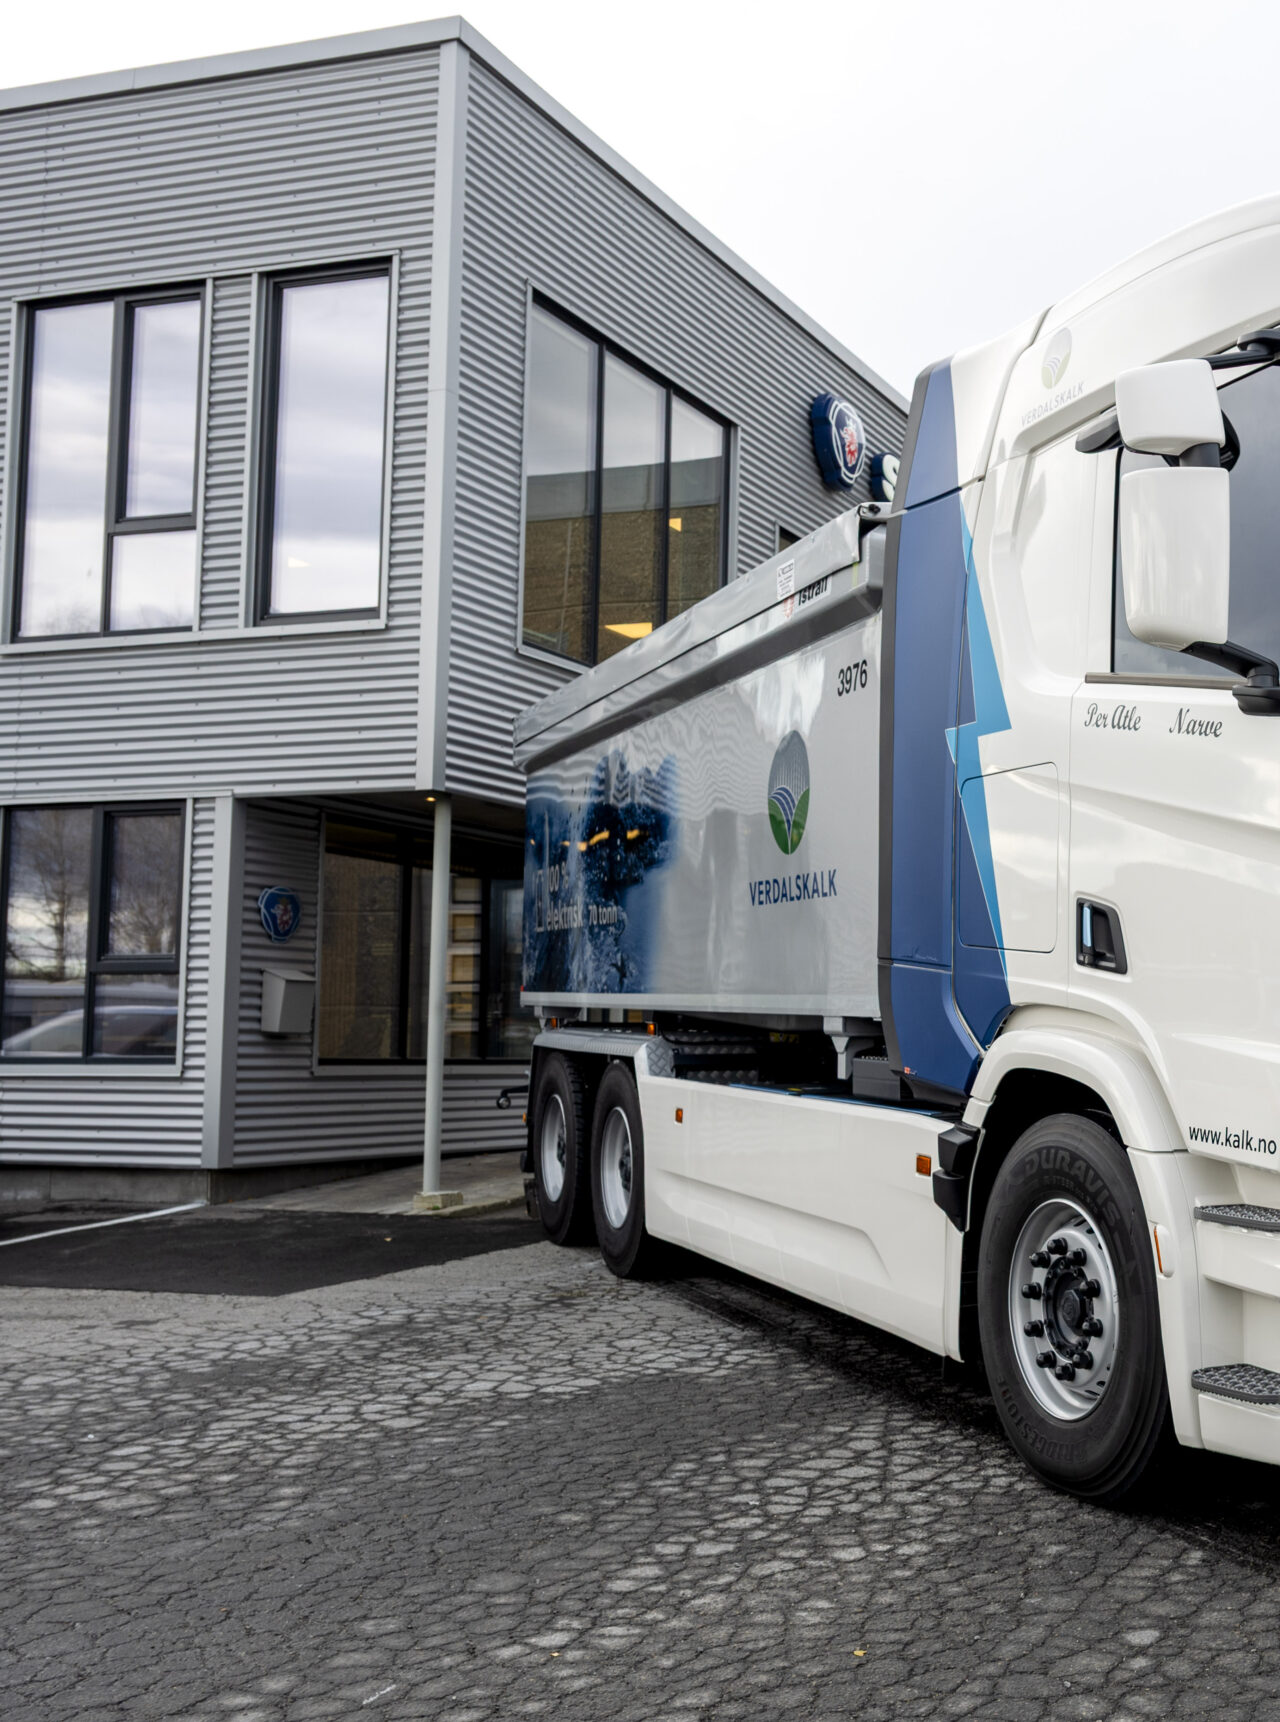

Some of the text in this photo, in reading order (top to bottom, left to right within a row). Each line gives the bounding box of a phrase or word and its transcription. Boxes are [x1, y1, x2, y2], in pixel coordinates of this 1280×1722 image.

[1020, 381, 1085, 427] VERDALSKALK
[837, 659, 868, 697] 3976
[1084, 702, 1142, 732] Per Atle
[1169, 707, 1224, 738] Narve
[749, 868, 838, 907] VERDALSKALK
[598, 903, 618, 926] tonn
[1188, 1126, 1277, 1155] www.kalk.no
